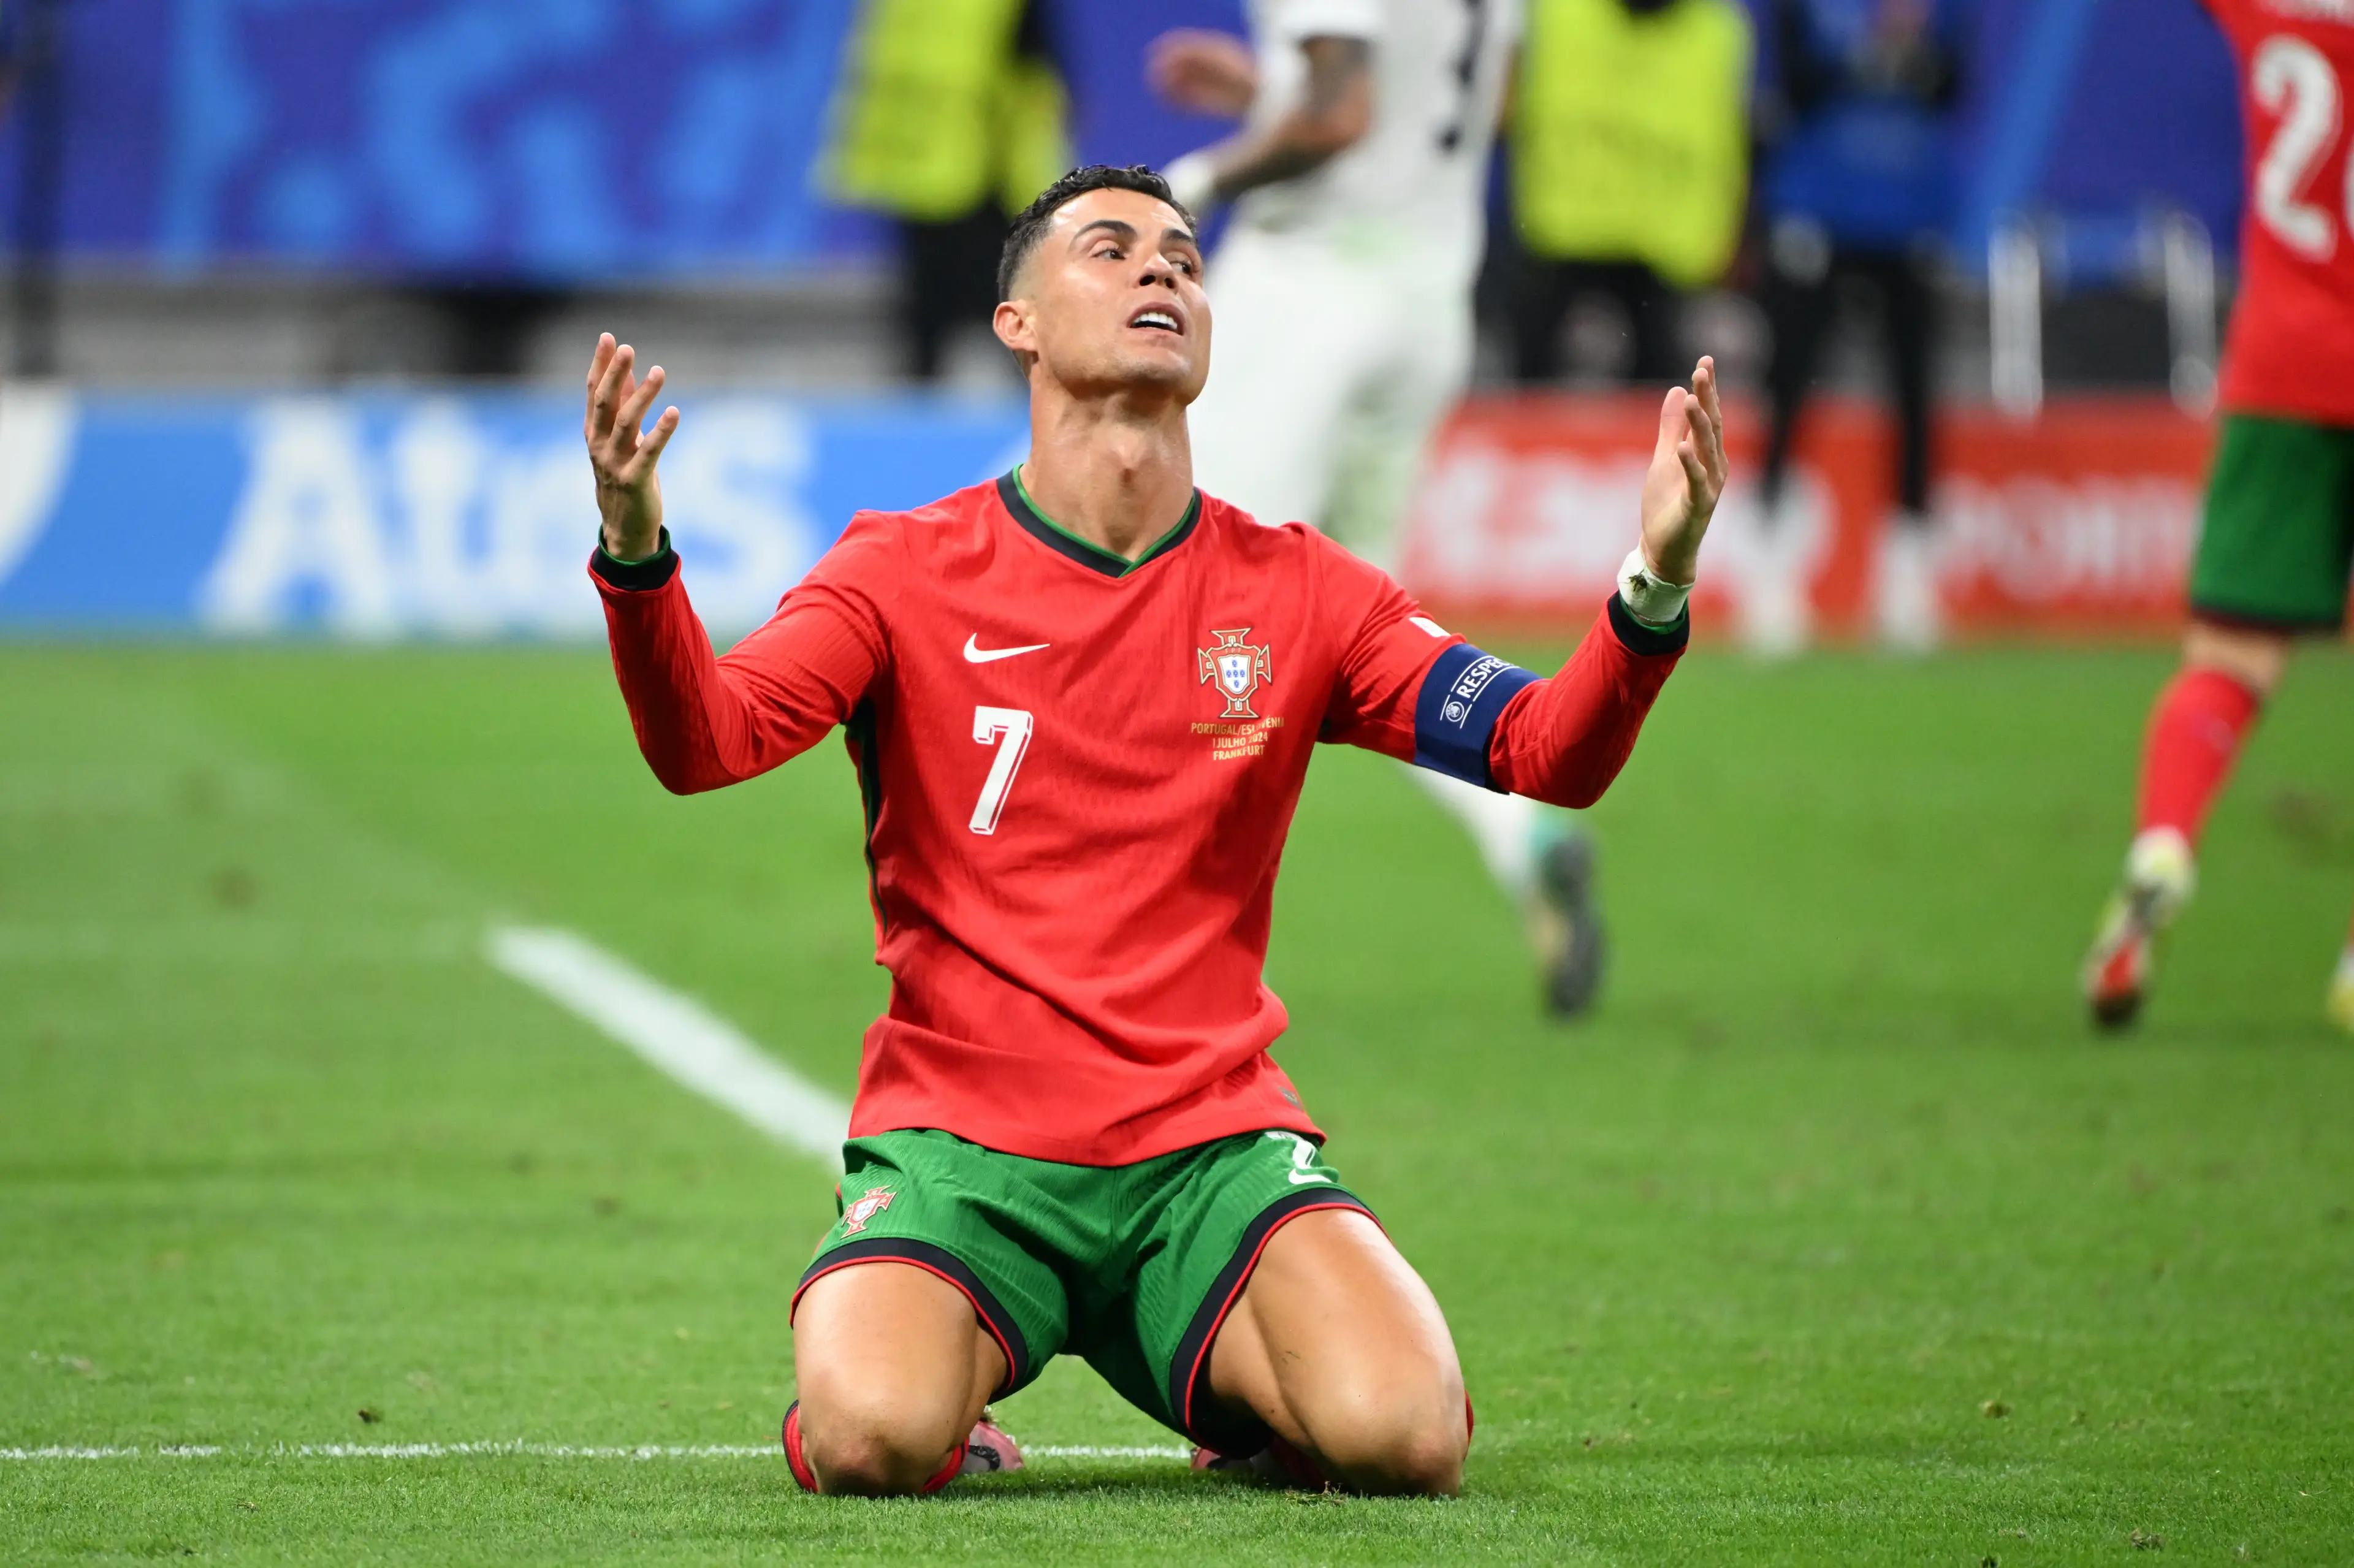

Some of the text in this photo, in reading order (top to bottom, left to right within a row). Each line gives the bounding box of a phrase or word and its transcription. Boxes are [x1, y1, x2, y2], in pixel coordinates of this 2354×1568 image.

[2250, 32, 2354, 264] 2
[1457, 657, 1513, 698] RESPEC
[1213, 744, 1265, 760] FRANKFURT
[1217, 736, 1246, 748] JULHO
[1248, 731, 1268, 744] 2024
[969, 706, 1034, 835] 7
